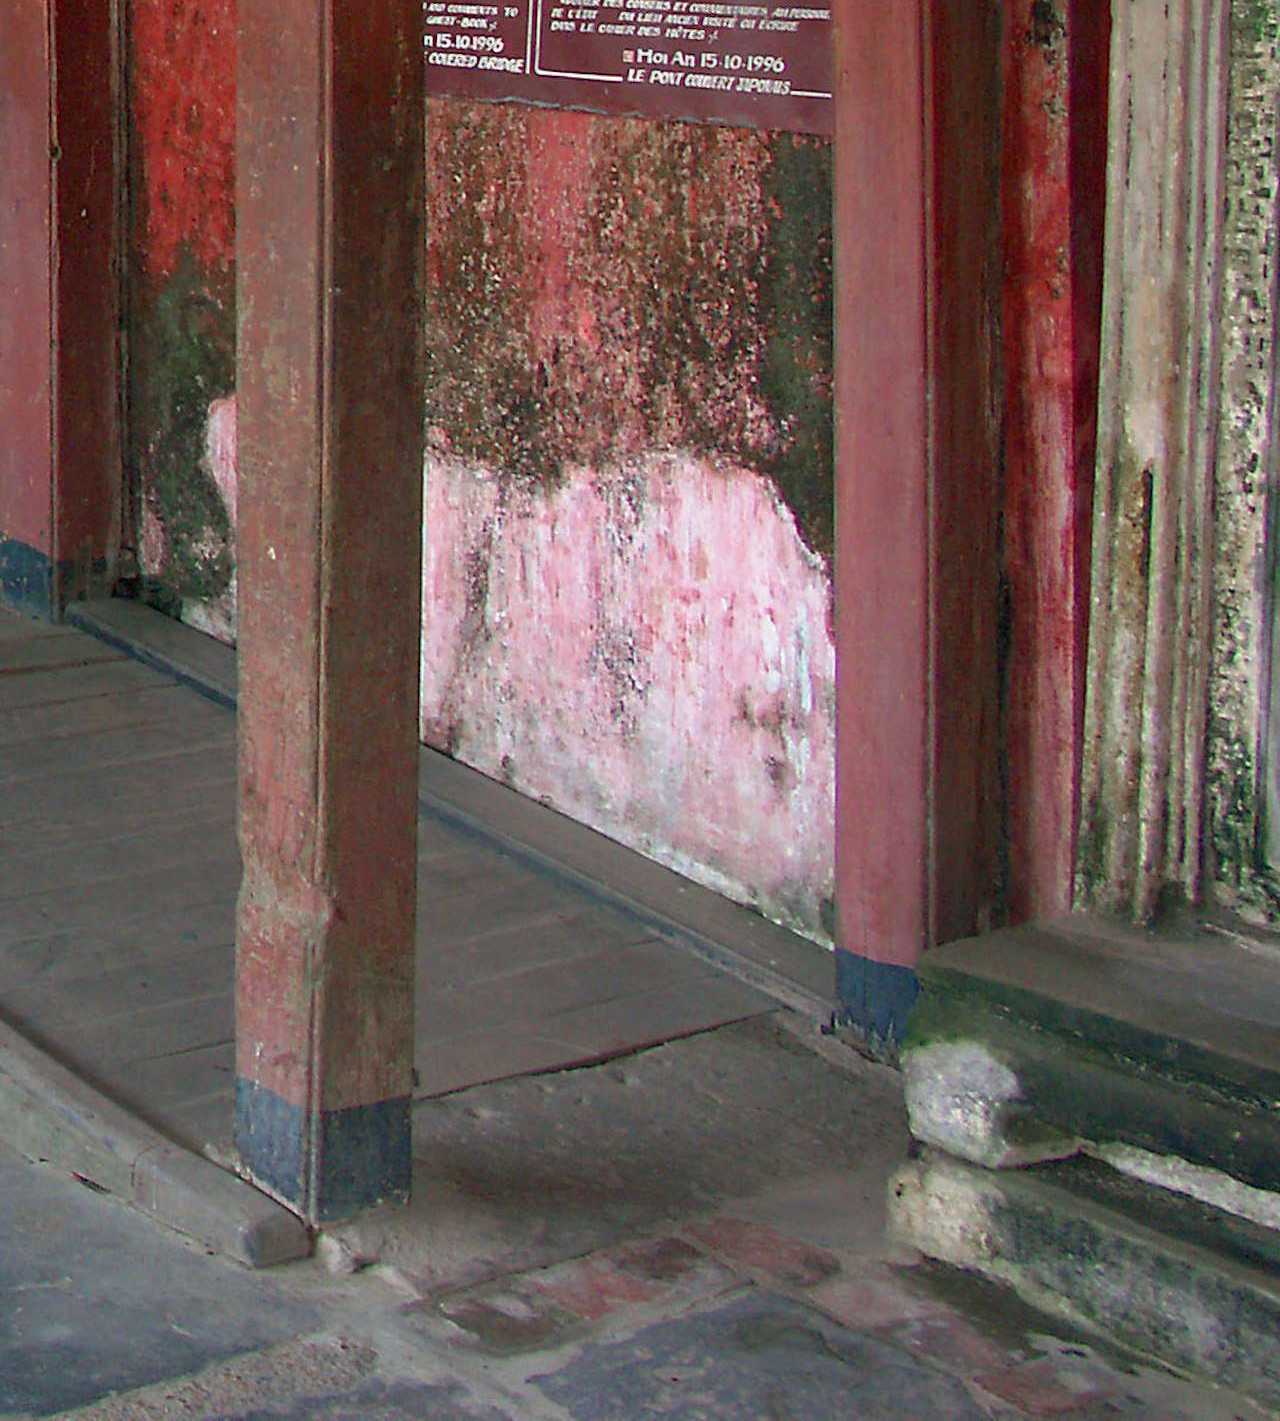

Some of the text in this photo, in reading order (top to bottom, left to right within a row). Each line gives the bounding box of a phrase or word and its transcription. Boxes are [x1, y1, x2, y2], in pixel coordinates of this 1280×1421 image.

[503, 6, 519, 18] TO
[423, 34, 434, 47] n
[477, 55, 525, 74] BRIDGE
[671, 50, 695, 67] An
[627, 68, 647, 83] LE
[648, 70, 684, 87] PONT
